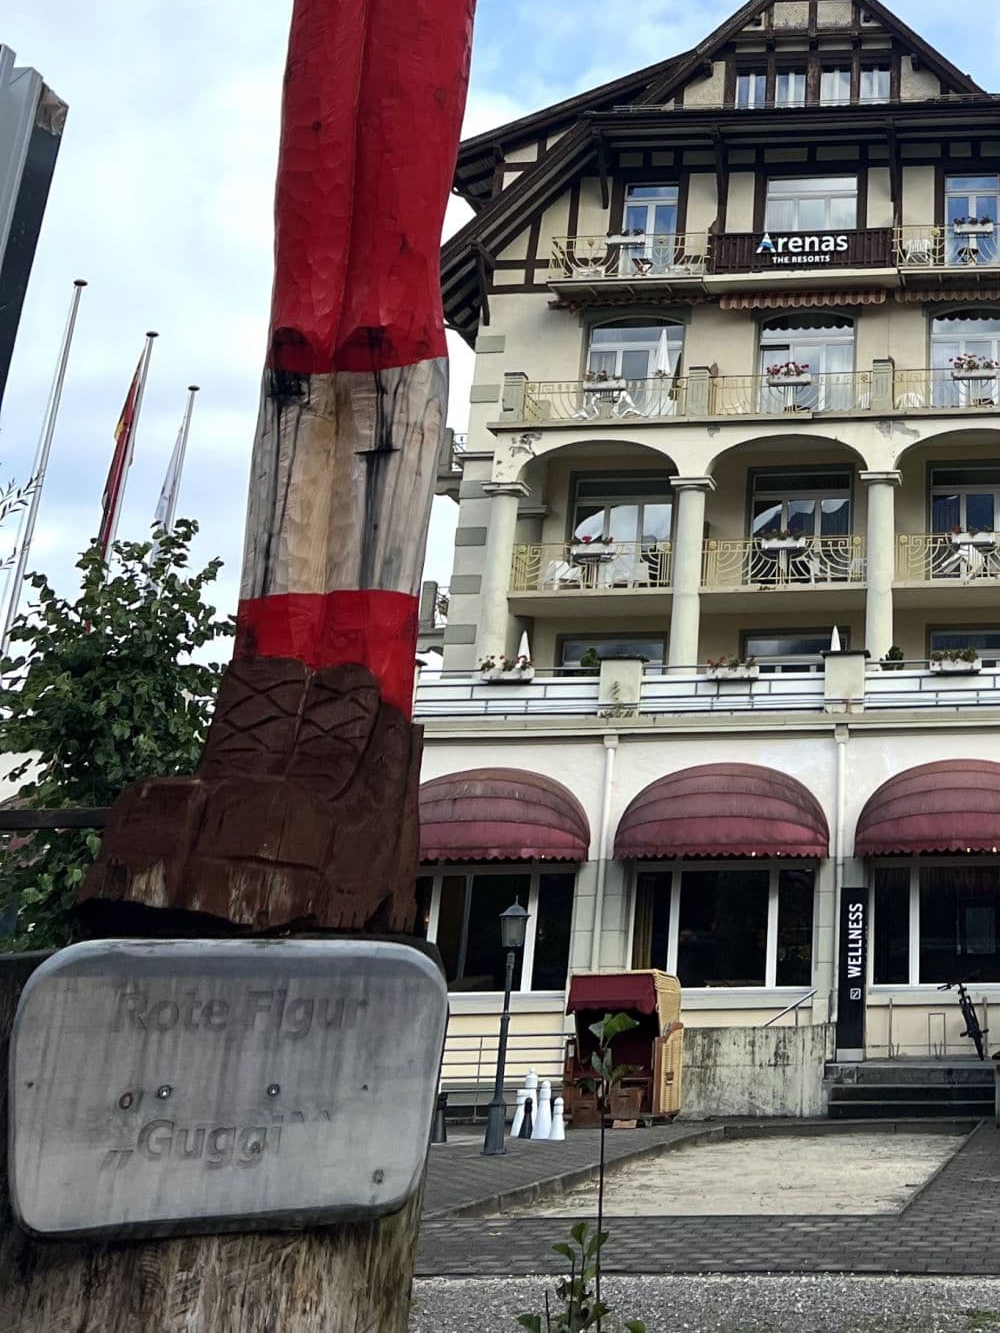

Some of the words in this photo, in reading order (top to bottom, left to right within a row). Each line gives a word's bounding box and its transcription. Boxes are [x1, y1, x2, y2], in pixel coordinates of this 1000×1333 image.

[756, 233, 848, 253] Arenas
[772, 255, 789, 264] THE
[791, 255, 831, 263] RESORTS
[848, 903, 863, 978] WELLNESS
[112, 991, 230, 1032] Rote
[240, 989, 369, 1037] Figur
